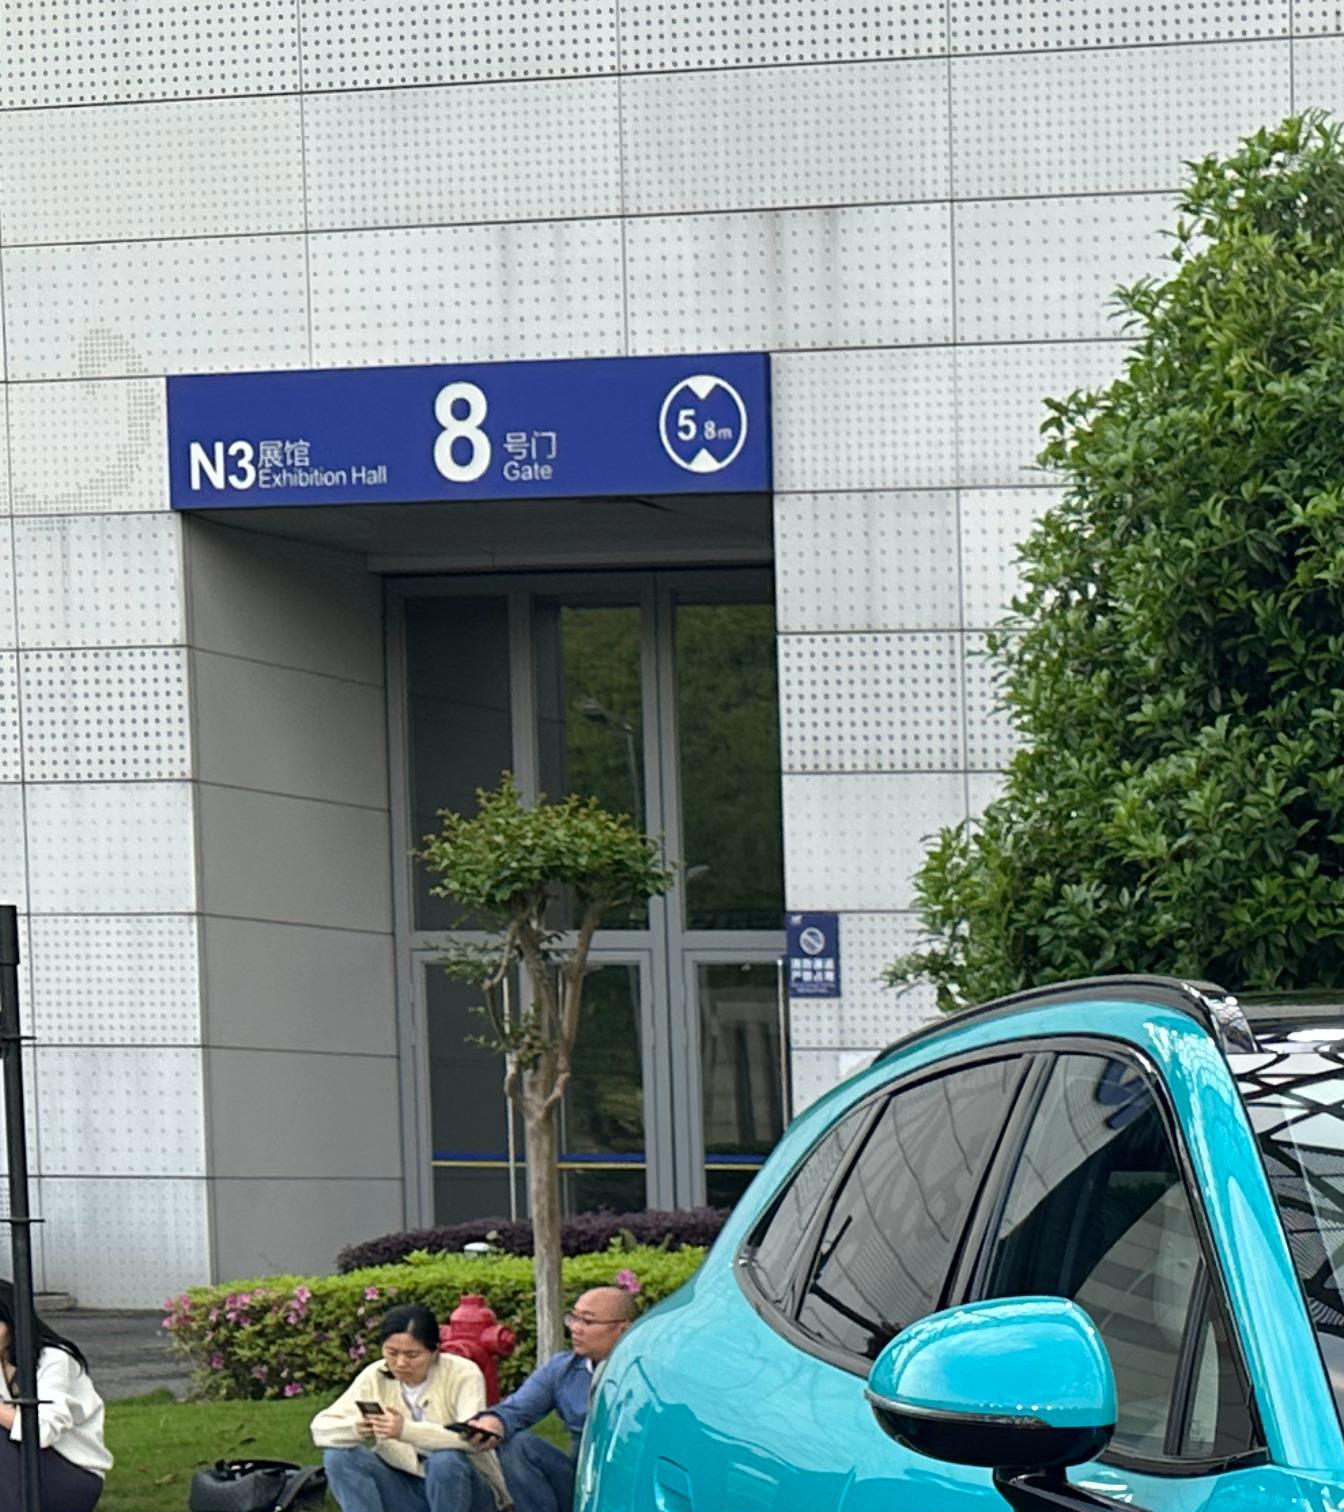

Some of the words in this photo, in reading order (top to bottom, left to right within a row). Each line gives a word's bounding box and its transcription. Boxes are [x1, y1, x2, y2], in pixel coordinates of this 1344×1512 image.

[434, 381, 492, 483] 8
[503, 431, 558, 460] 号门
[189, 440, 257, 491] N3
[258, 438, 311, 468] 展馆
[258, 469, 347, 489] Exhibition
[351, 464, 388, 486] Hall
[503, 461, 553, 482] Gate
